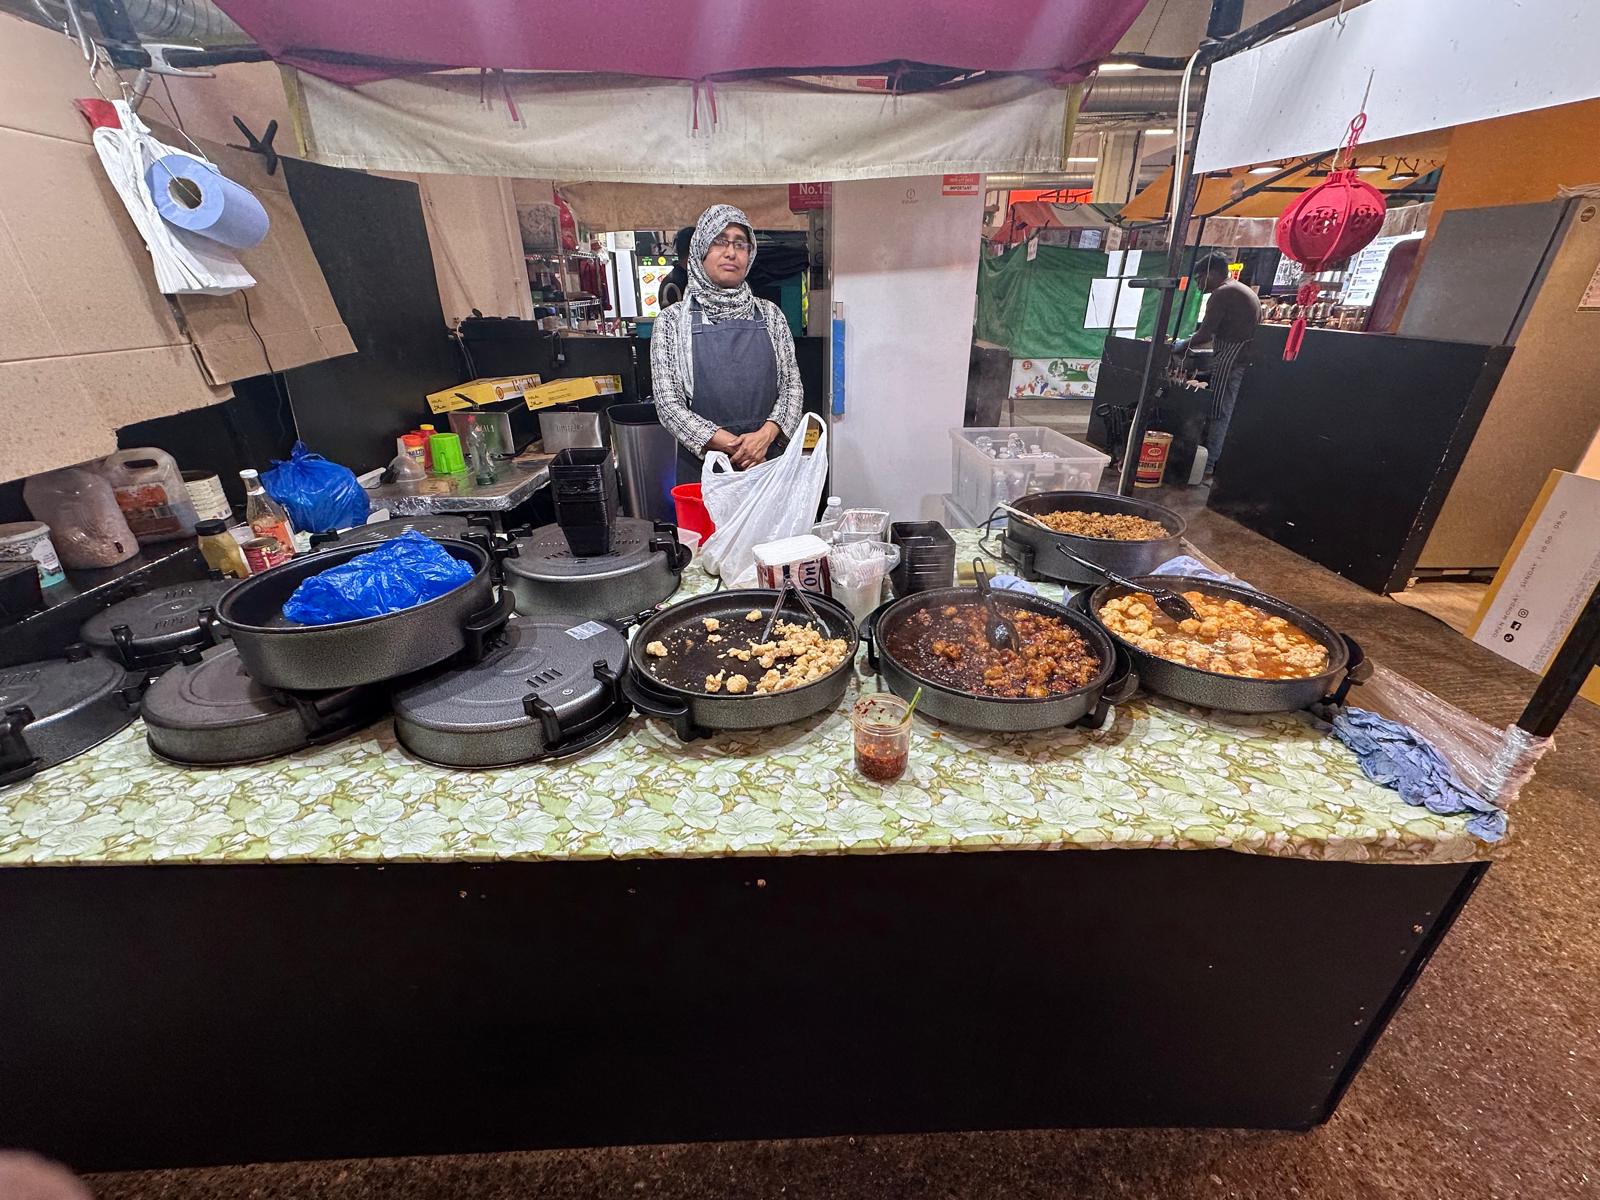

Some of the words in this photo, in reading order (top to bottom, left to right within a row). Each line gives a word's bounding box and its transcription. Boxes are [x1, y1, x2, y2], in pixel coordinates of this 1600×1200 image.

[799, 183, 823, 195] No.1
[1502, 593, 1519, 620] MONDAY
[1520, 562, 1537, 588] SUNDAY
